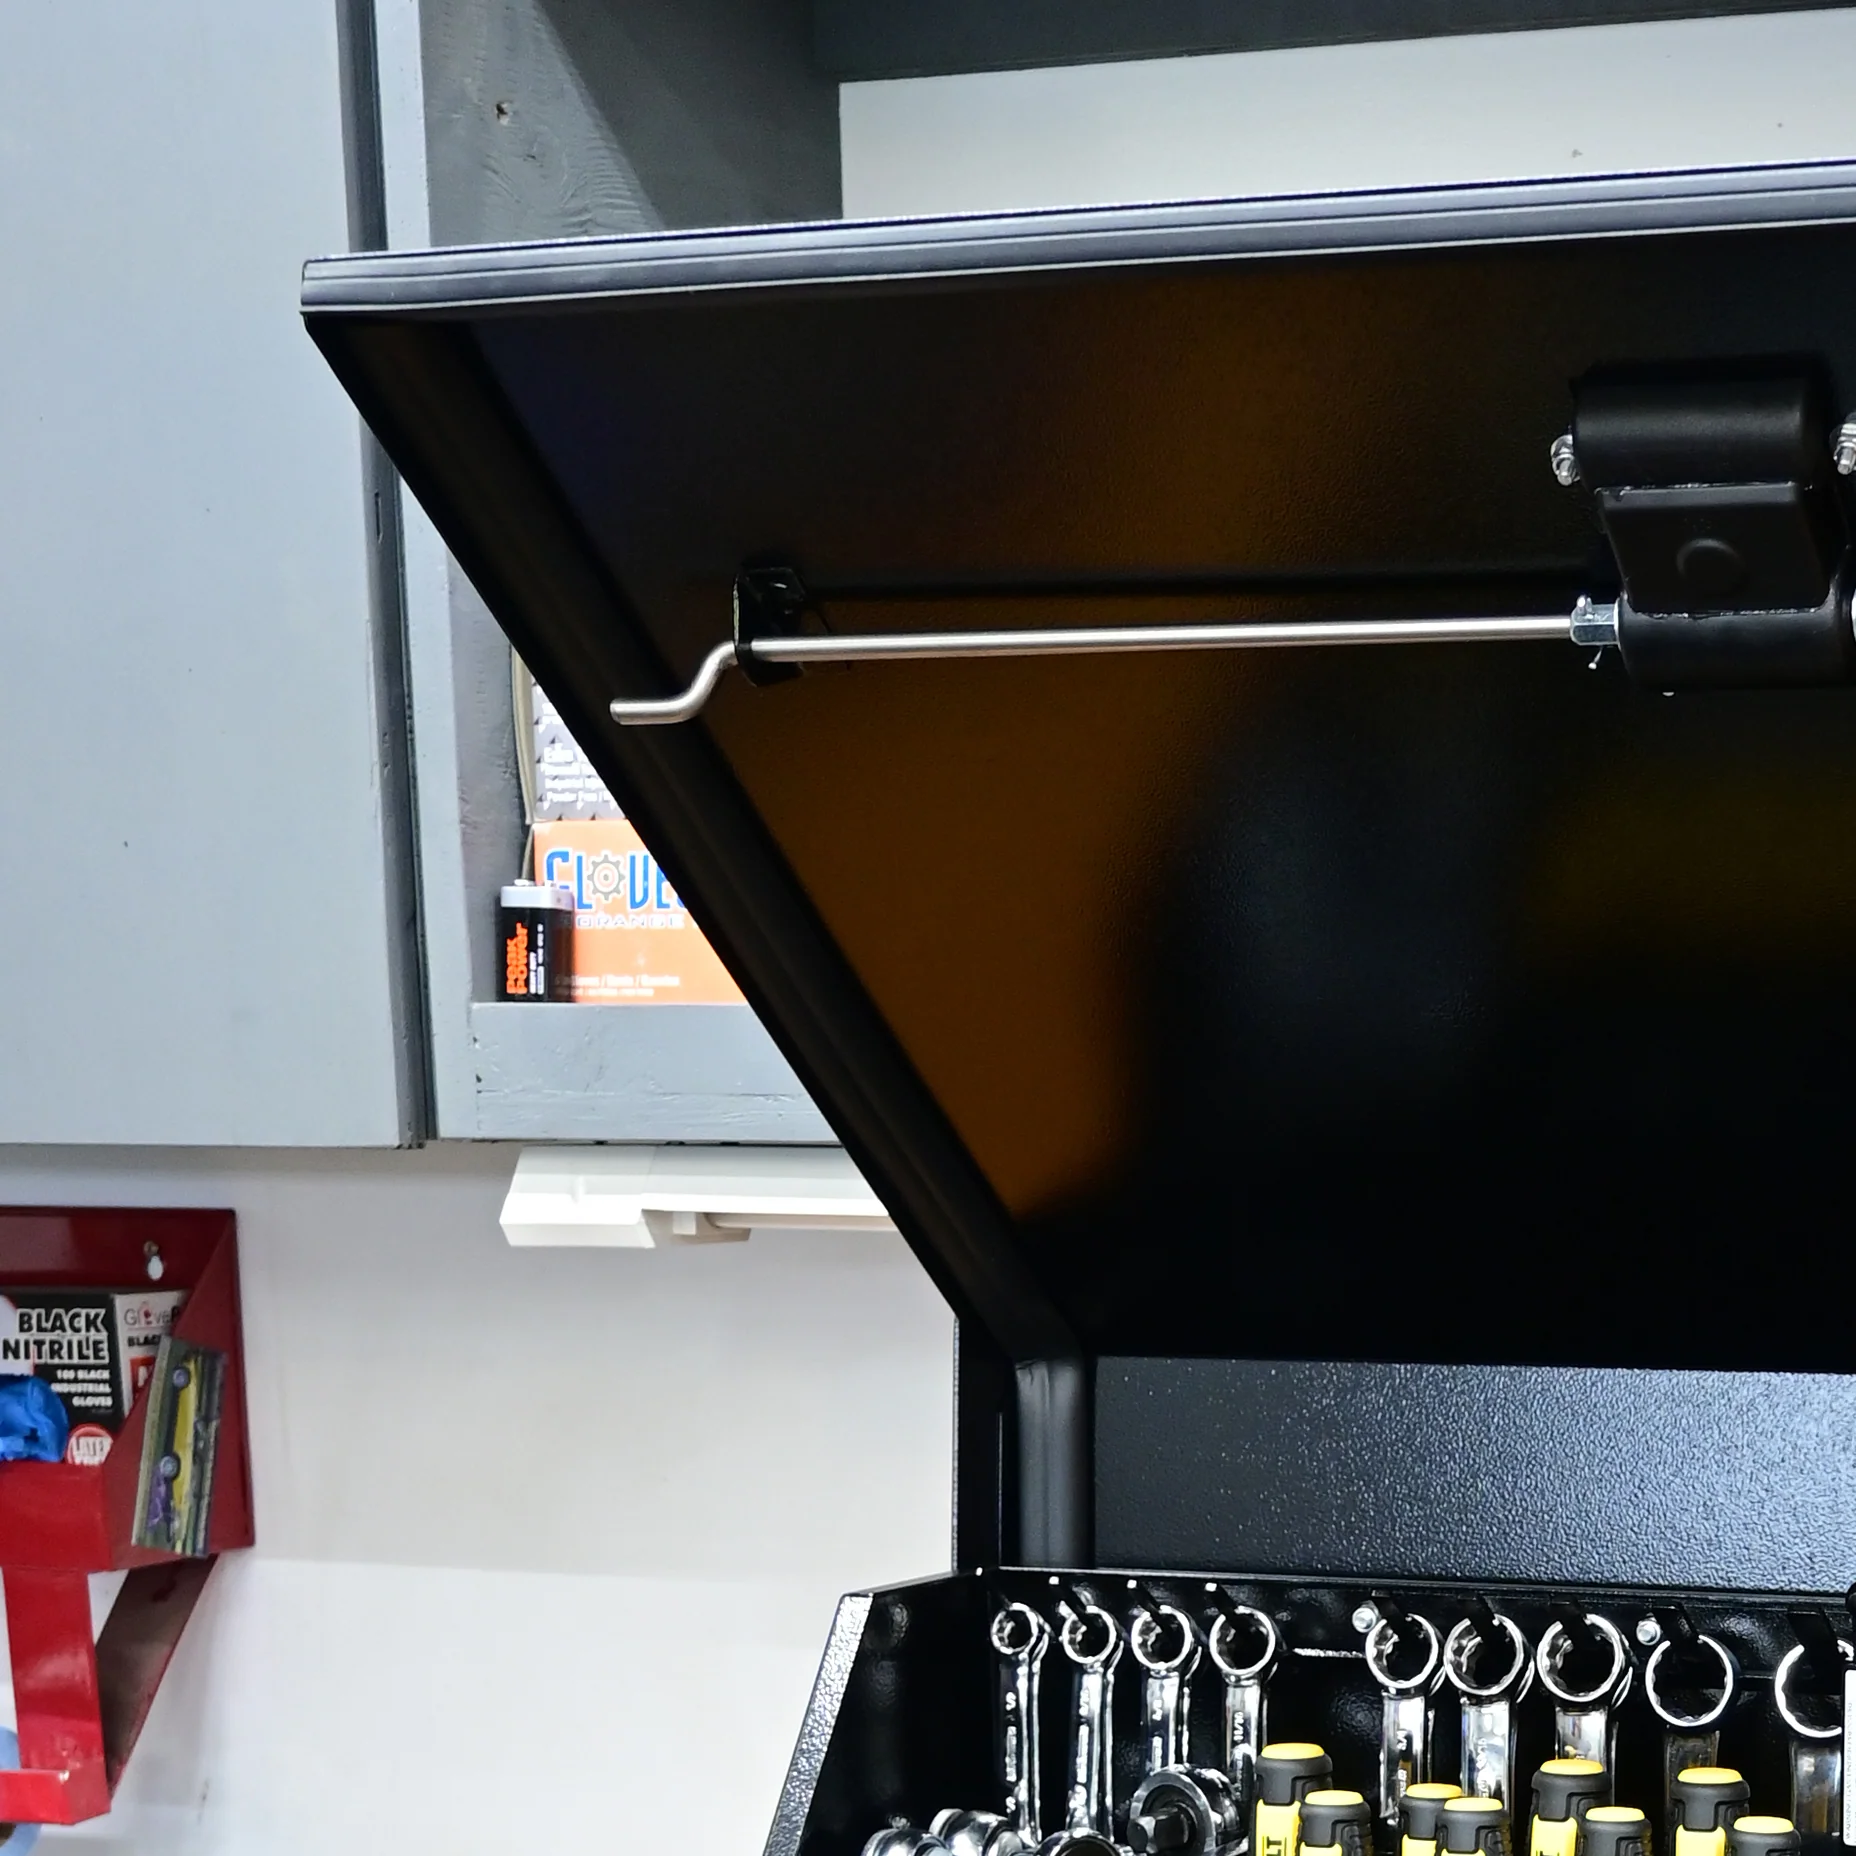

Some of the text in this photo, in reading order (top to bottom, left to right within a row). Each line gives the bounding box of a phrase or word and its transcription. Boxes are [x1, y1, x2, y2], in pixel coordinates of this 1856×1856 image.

[546, 850, 686, 910] GLOVE
[17, 1308, 108, 1335] BLACK
[2, 1337, 109, 1364] NITRILE
[56, 1368, 110, 1381] 100 BLACK
[51, 1383, 112, 1395] INDUSTRIAL
[72, 1395, 113, 1408] GLOVES
